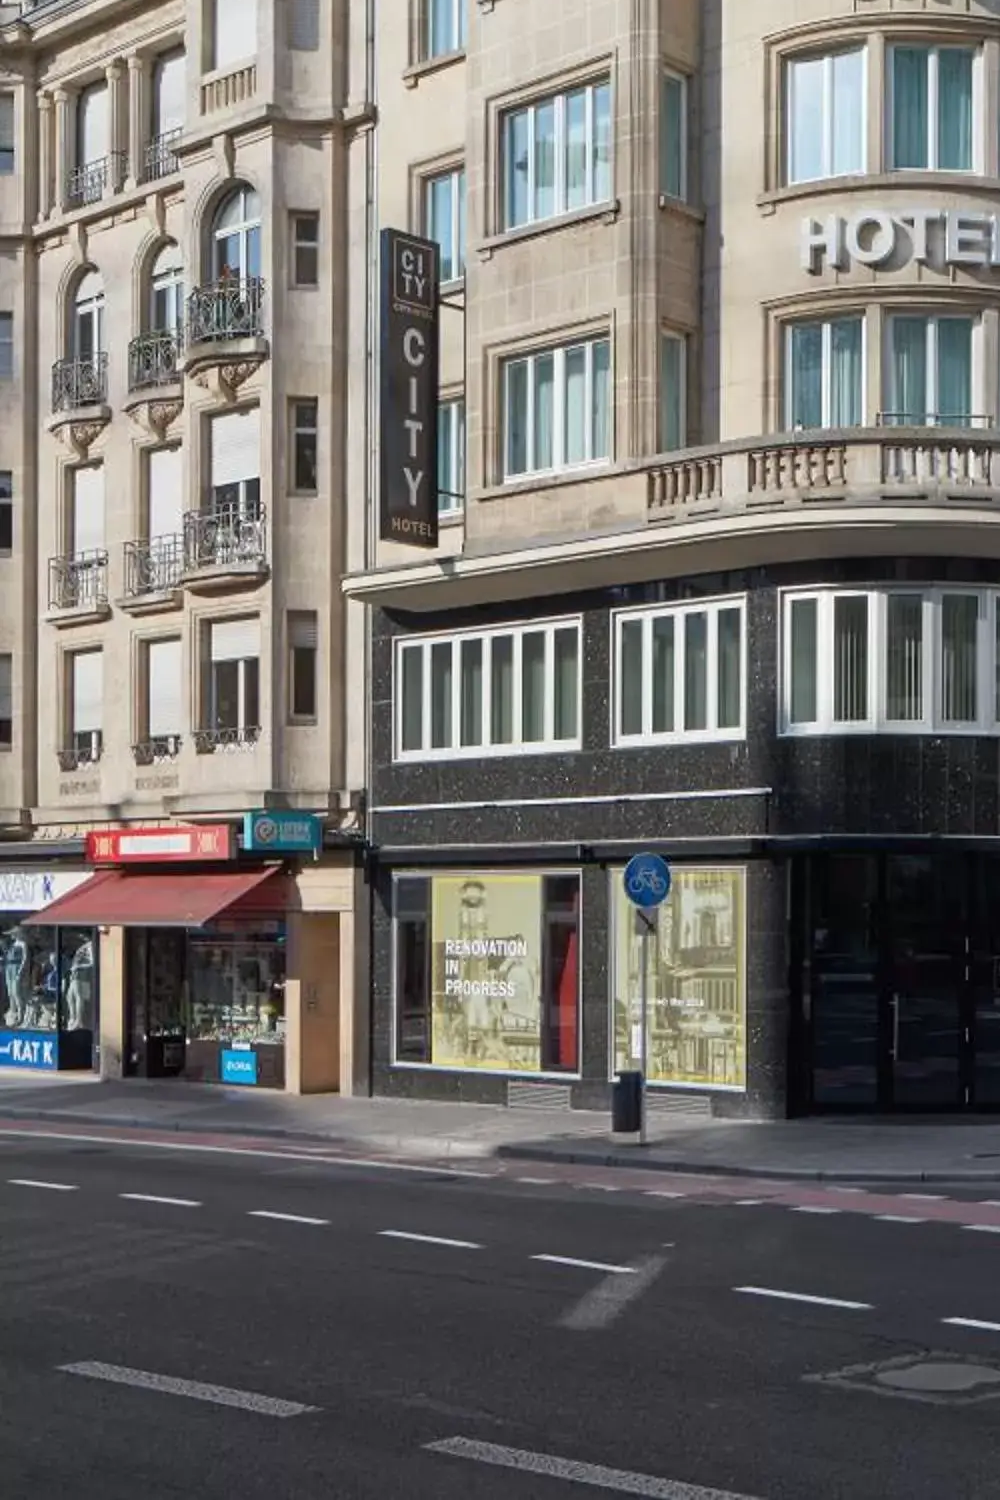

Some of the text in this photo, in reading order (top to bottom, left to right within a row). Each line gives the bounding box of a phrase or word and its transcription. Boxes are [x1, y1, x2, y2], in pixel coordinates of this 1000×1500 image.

[403, 327, 425, 507] CITY
[391, 516, 434, 538] HOTEL
[445, 939, 527, 957] RENOVATION
[445, 959, 459, 975] IN
[445, 980, 515, 997] PROGRESS
[13, 1038, 53, 1065] KAT K
